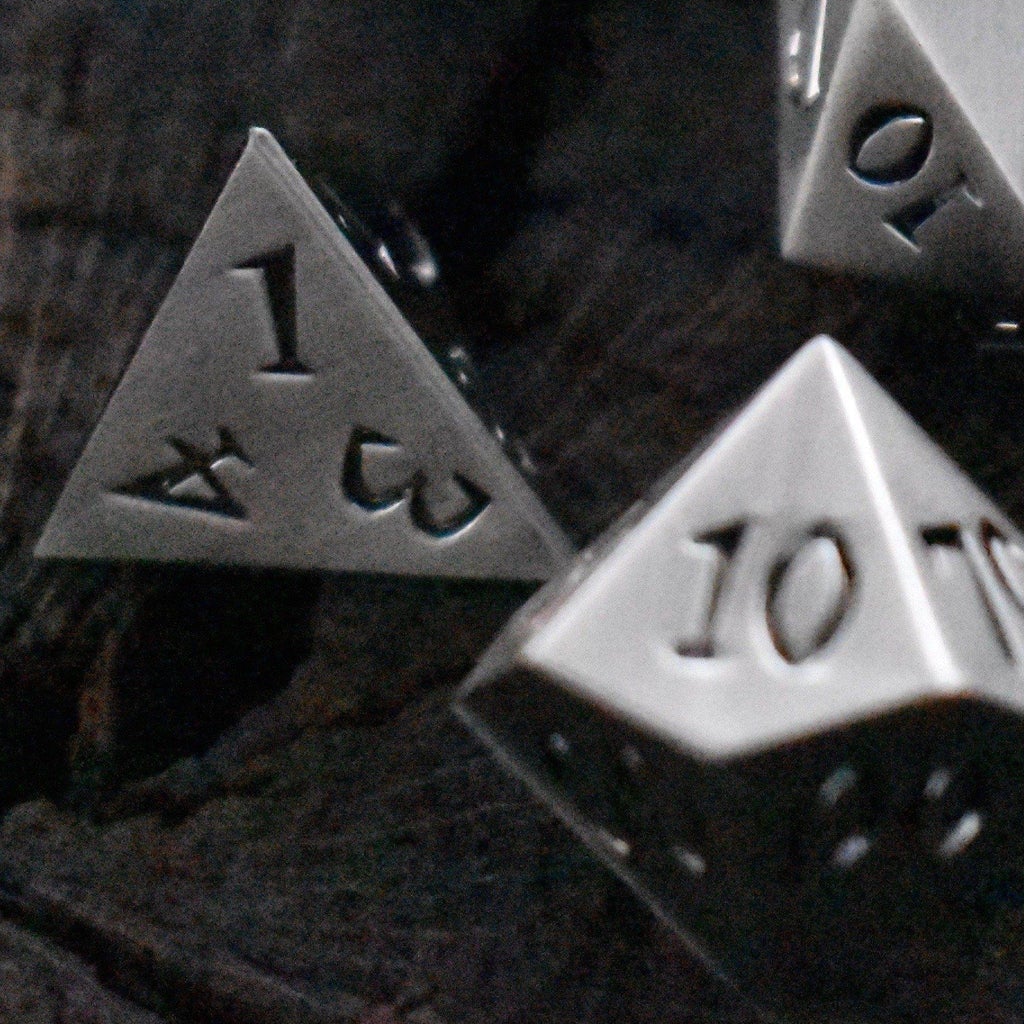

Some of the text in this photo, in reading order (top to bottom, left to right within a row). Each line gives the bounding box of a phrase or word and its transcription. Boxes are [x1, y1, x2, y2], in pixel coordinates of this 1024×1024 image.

[226, 242, 314, 378] 1
[106, 426, 254, 520] 4
[340, 424, 492, 542] 3
[674, 517, 858, 668] 10
